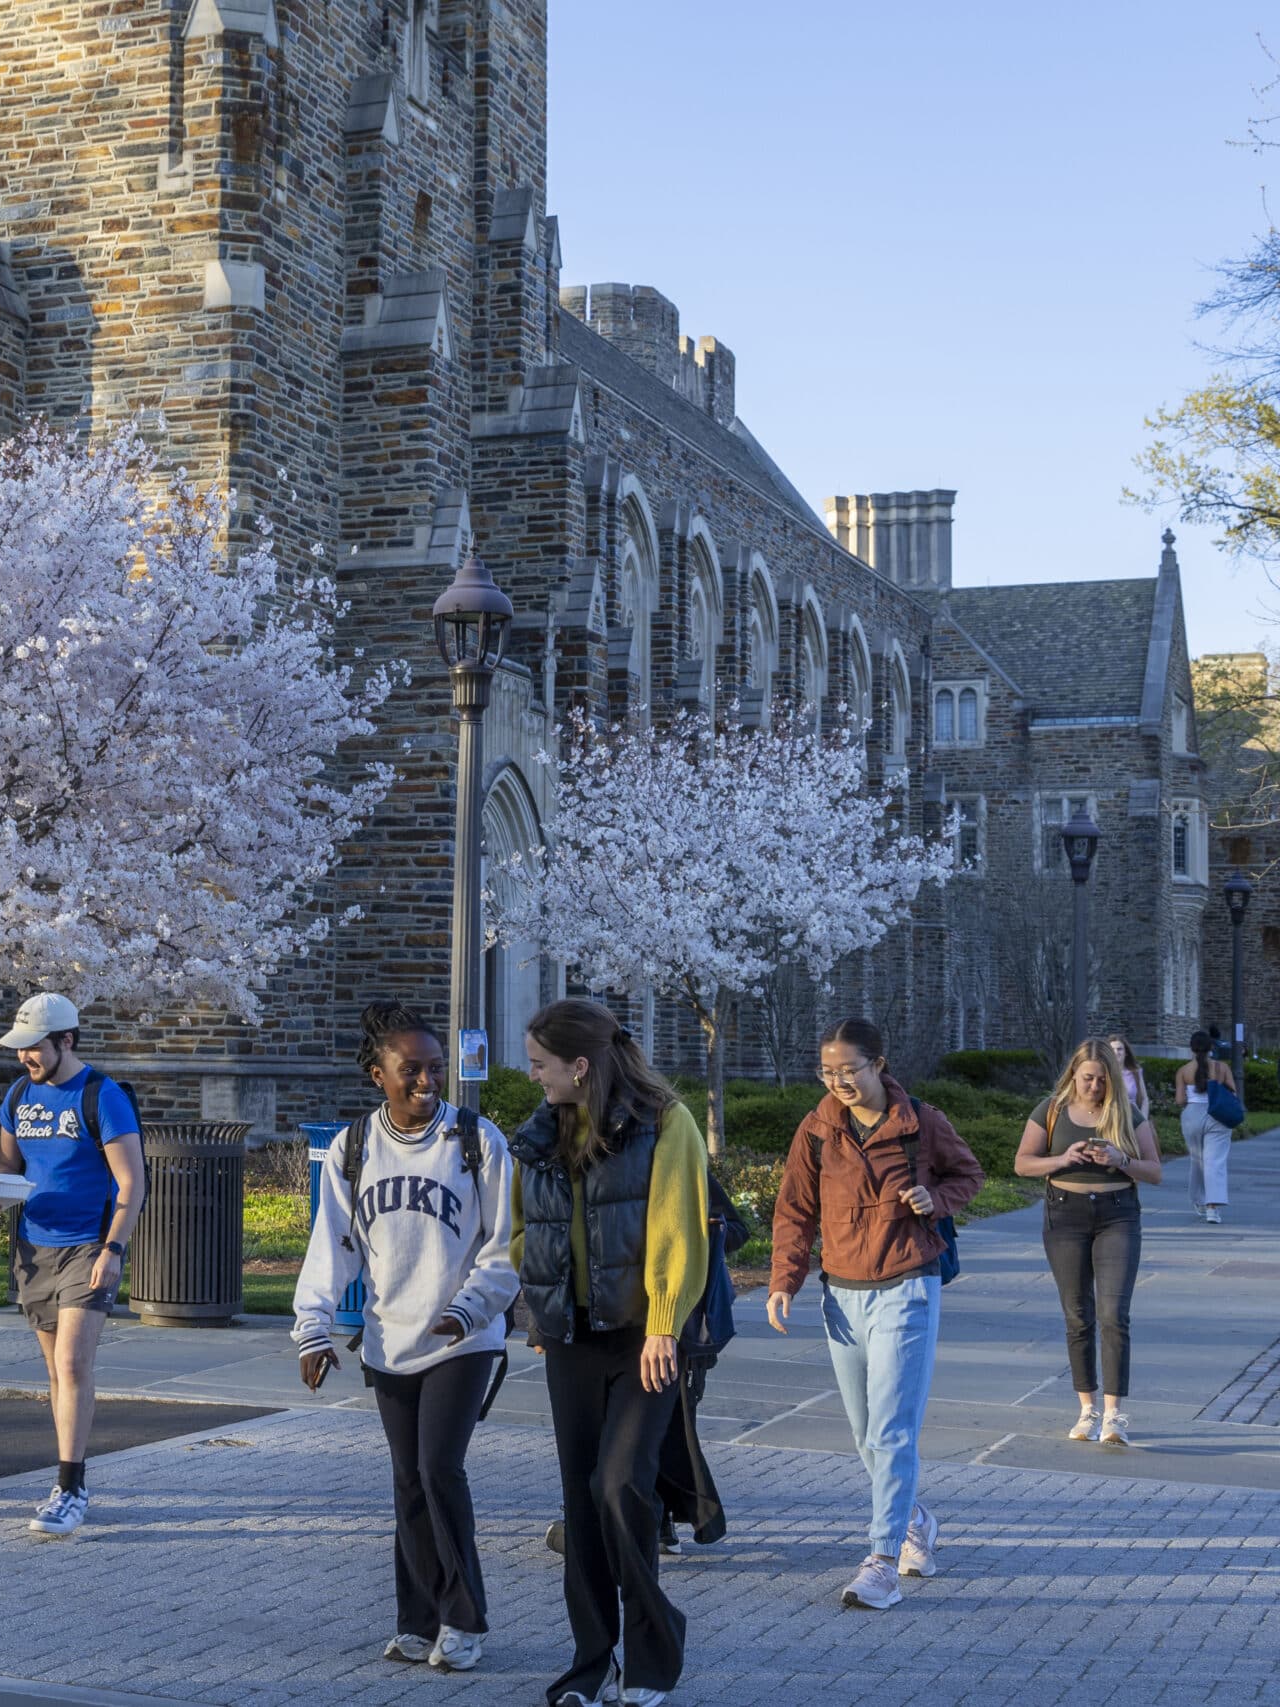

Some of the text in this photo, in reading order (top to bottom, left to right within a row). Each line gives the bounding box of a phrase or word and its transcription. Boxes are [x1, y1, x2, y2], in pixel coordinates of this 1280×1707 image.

[16, 1103, 54, 1120] We're
[16, 1120, 53, 1138] Back
[358, 1176, 462, 1240] DUKE
